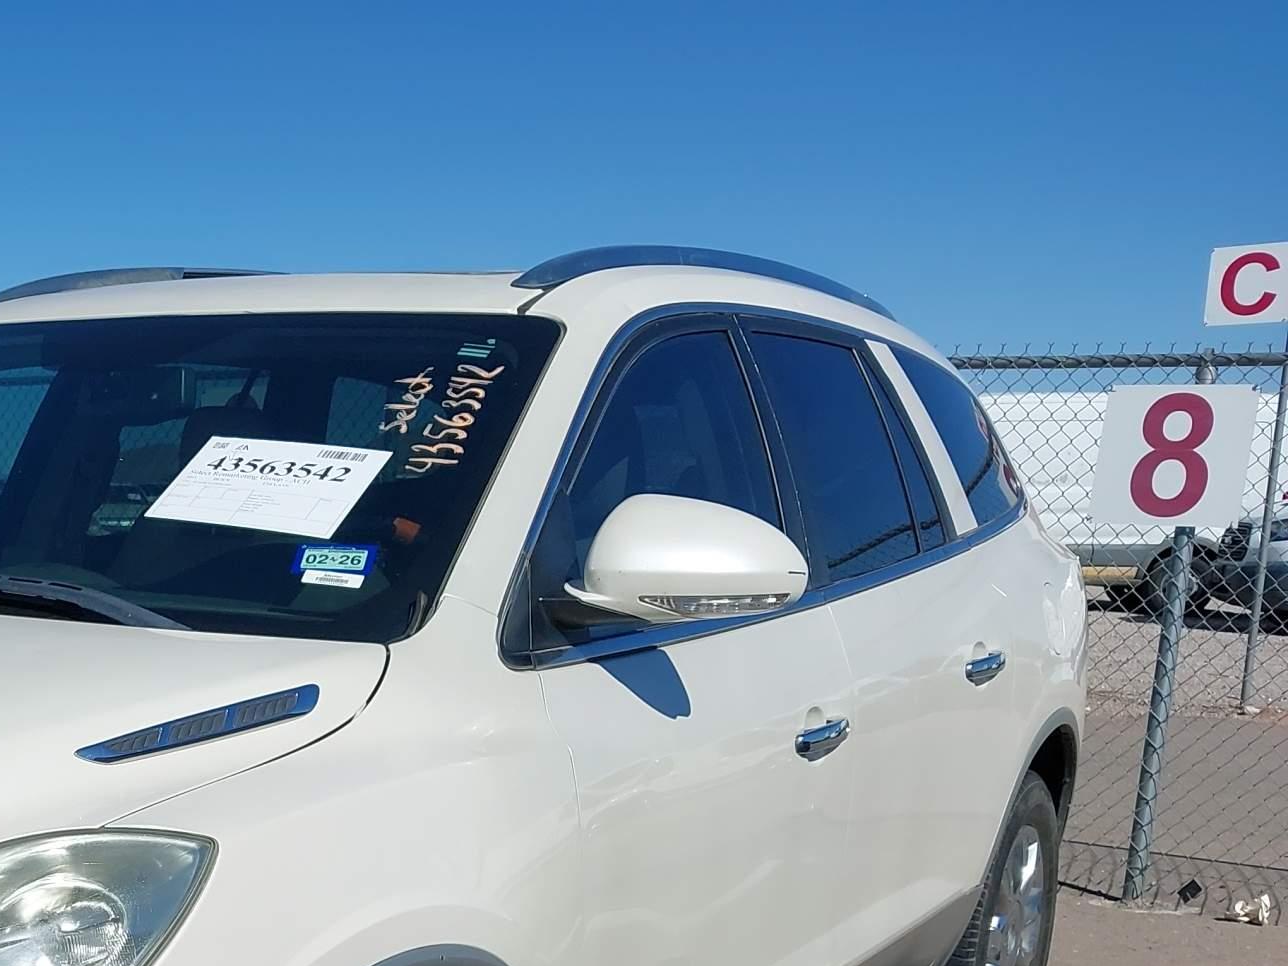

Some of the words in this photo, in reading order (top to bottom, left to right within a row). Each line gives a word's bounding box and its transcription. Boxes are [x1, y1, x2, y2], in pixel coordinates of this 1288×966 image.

[1220, 252, 1280, 317] C
[404, 364, 505, 473] 43563542
[1130, 392, 1214, 518] 8
[207, 455, 352, 482] 43563542
